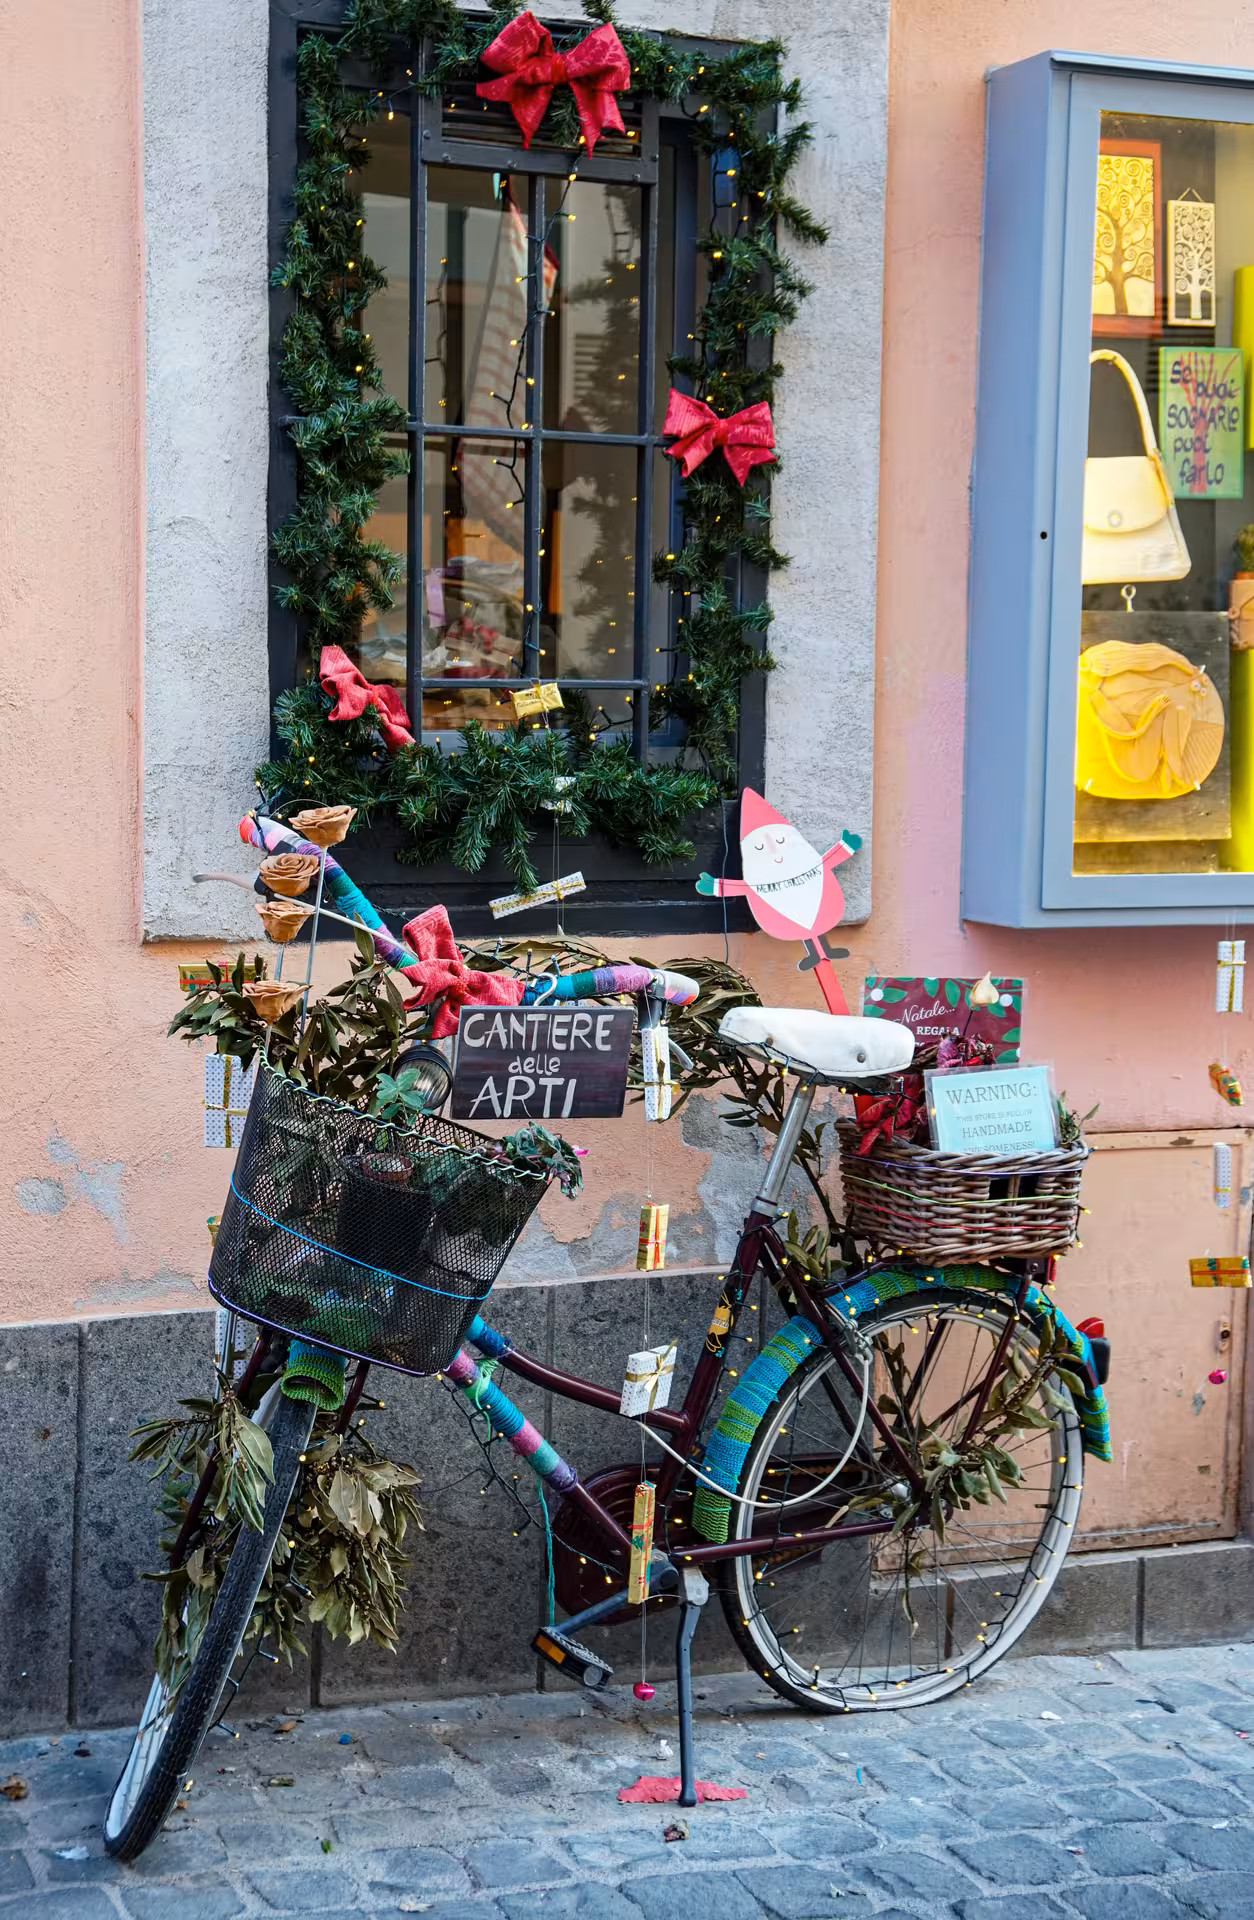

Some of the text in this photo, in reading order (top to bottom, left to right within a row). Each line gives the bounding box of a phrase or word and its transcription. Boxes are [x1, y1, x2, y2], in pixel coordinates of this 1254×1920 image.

[1170, 361, 1192, 384] Se
[1173, 433, 1212, 462] puoi
[756, 868, 822, 893] MERRY CHRISTMAS
[463, 1012, 615, 1051] CANTIERE
[508, 1054, 561, 1076] delle
[468, 1075, 577, 1119] ARTI
[945, 1082, 1037, 1104] WARNING:
[974, 1112, 997, 1121] STORE
[961, 1120, 1033, 1138] HANDMADE
